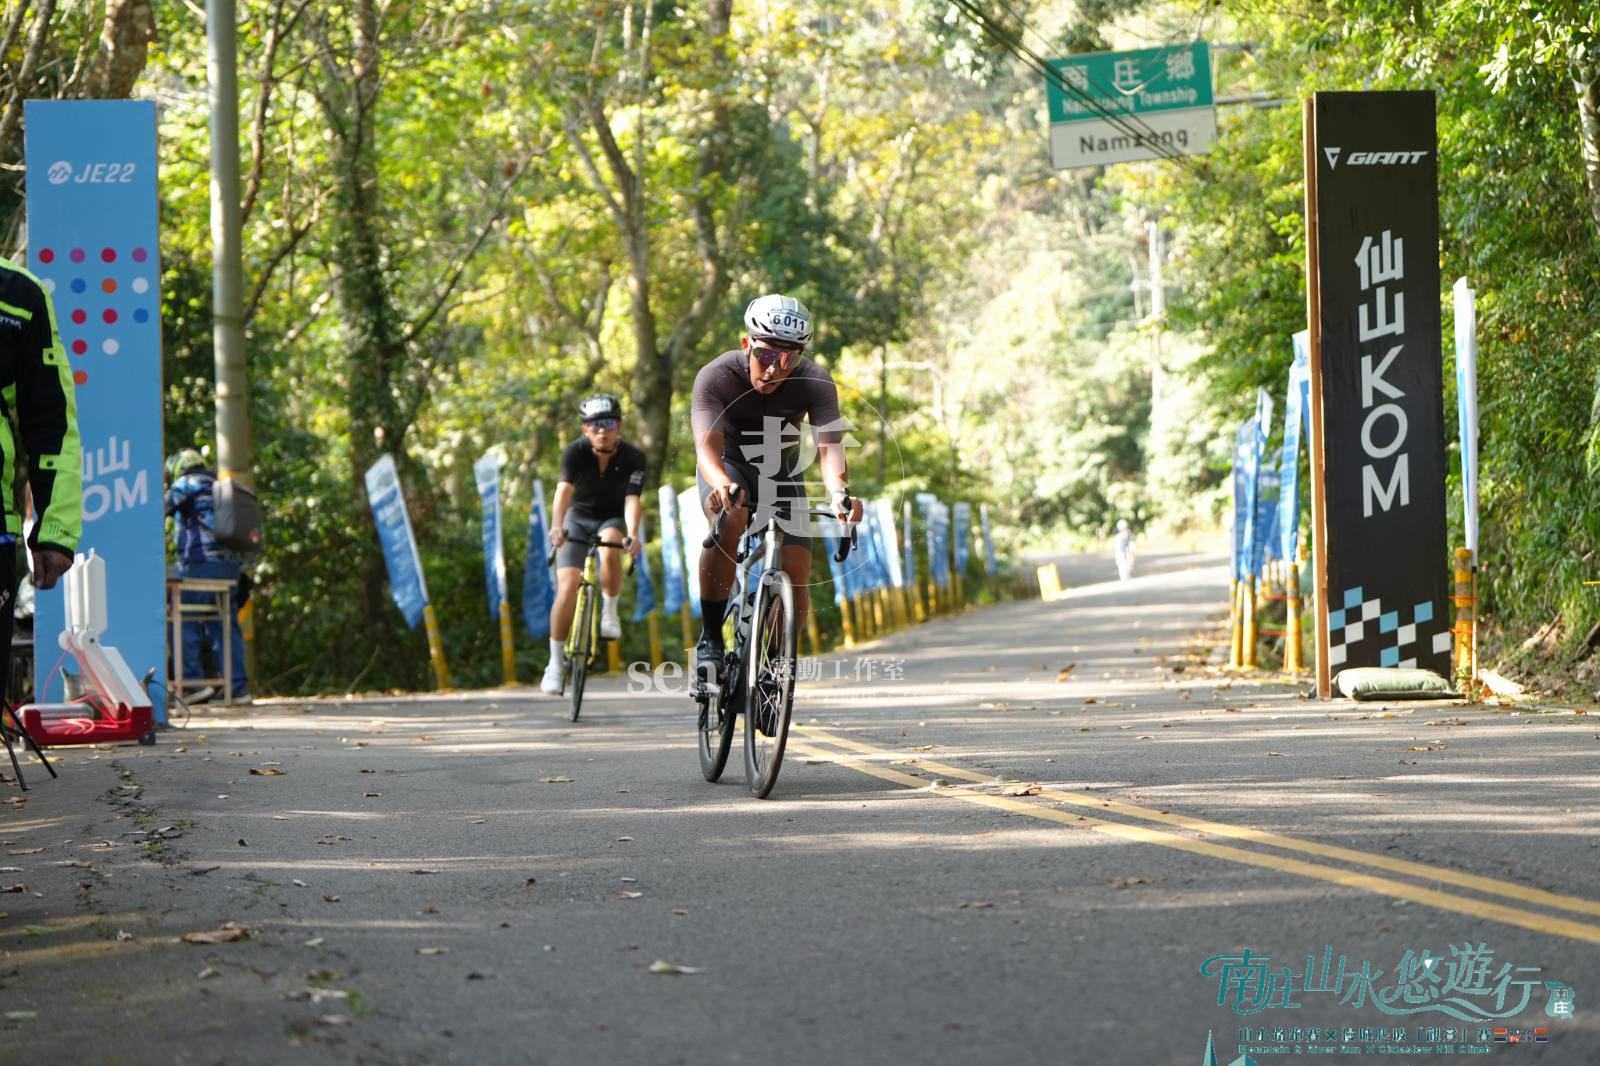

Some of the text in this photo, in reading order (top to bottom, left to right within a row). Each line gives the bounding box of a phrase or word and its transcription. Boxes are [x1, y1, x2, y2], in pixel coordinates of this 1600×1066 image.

[1139, 87, 1198, 106] Township
[1346, 151, 1428, 165] GIANT
[74, 163, 136, 183] JE22
[81, 469, 148, 522] OM
